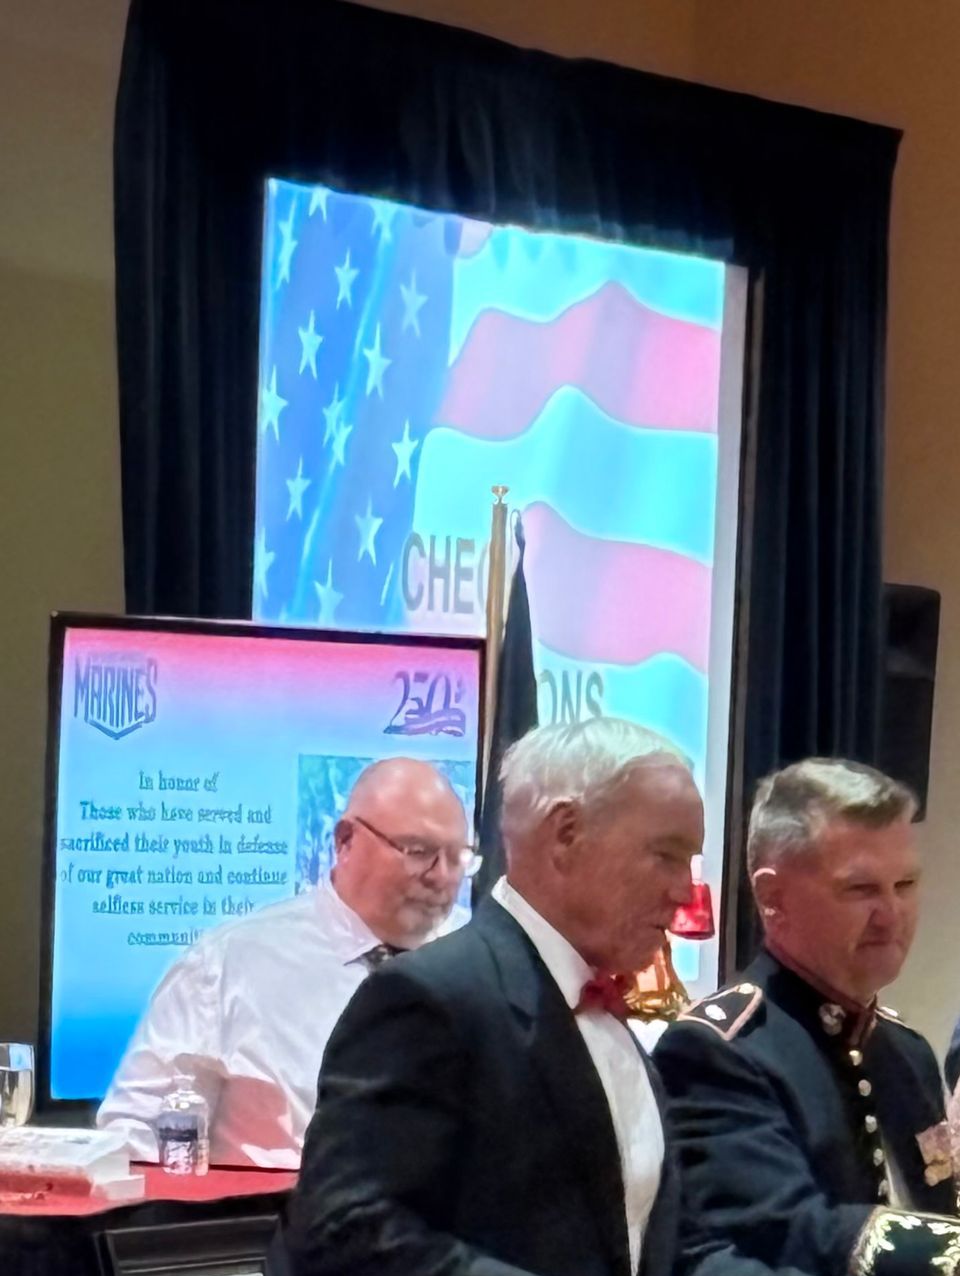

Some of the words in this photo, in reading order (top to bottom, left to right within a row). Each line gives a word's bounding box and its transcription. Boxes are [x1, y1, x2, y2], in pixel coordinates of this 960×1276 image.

[74, 656, 157, 729] MARINES
[139, 770, 153, 791] In
[159, 770, 200, 792] honor
[203, 771, 220, 793] of
[80, 800, 121, 821] Those
[126, 801, 156, 821] who
[161, 801, 194, 822] have
[197, 803, 242, 824] served
[247, 804, 272, 824] and
[60, 832, 130, 853] sacrificed
[135, 832, 170, 853] their
[172, 833, 214, 859] youth
[218, 834, 232, 855] in
[60, 862, 75, 884] of
[77, 869, 102, 884] our
[105, 865, 143, 889] great
[147, 865, 192, 884] nation
[197, 864, 223, 885] and
[226, 866, 288, 885] continue
[91, 894, 145, 915] selfless
[148, 895, 199, 915] service
[203, 895, 217, 916] in
[221, 895, 255, 917] their
